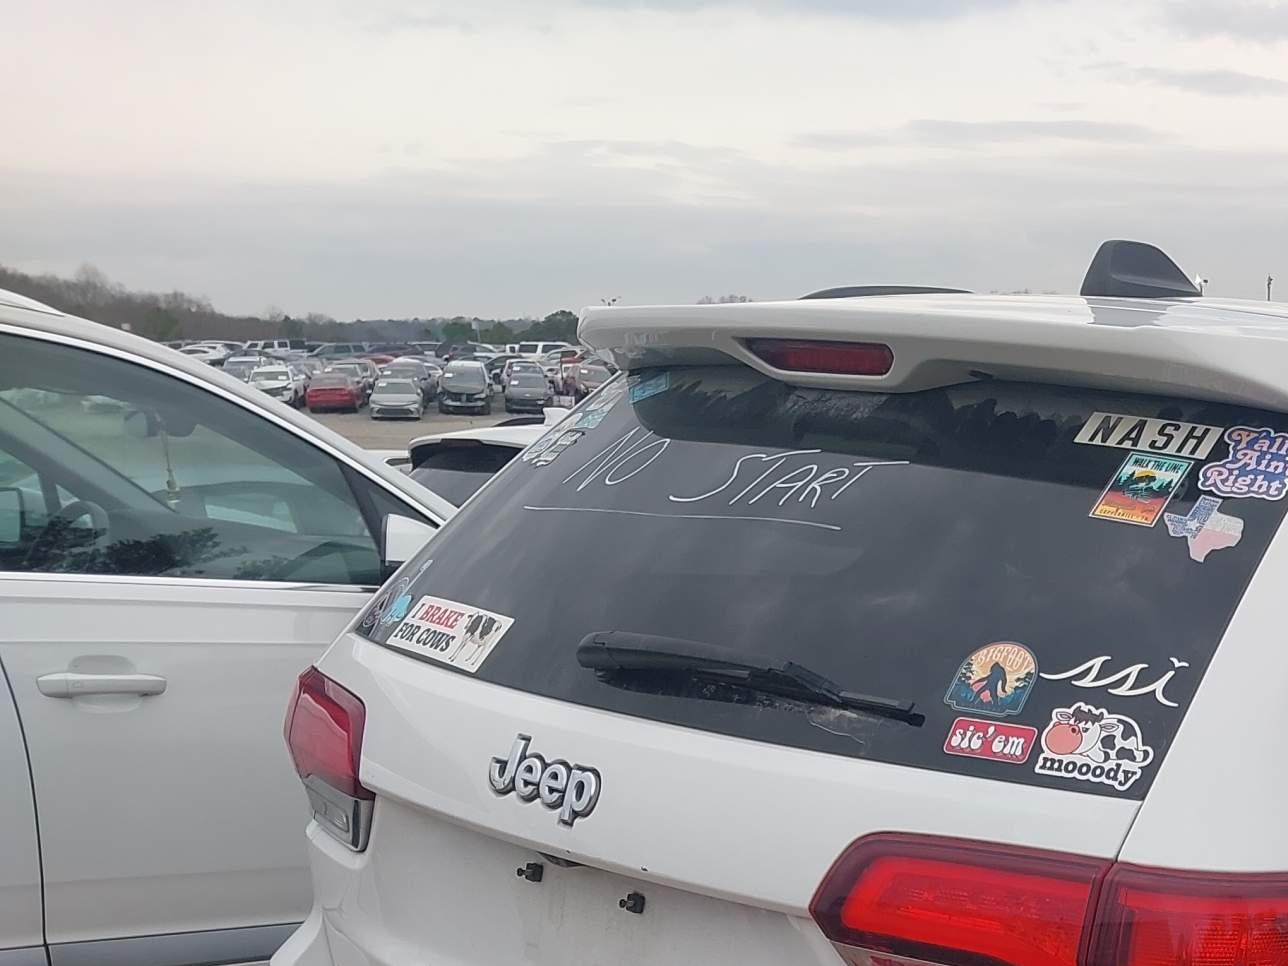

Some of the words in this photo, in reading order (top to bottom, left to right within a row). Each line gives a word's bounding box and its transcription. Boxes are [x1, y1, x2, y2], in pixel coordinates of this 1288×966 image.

[1089, 415, 1212, 456] NASH
[562, 426, 671, 492] NO
[669, 448, 910, 508] START
[1206, 466, 1282, 496] Right
[411, 602, 426, 620] I
[420, 605, 466, 630] BRAKE
[393, 622, 418, 643] FOR
[416, 628, 457, 653] COWS
[976, 645, 1034, 673] BIGFOOT
[489, 733, 602, 828] Jeep
[1038, 754, 1138, 787] mooody
